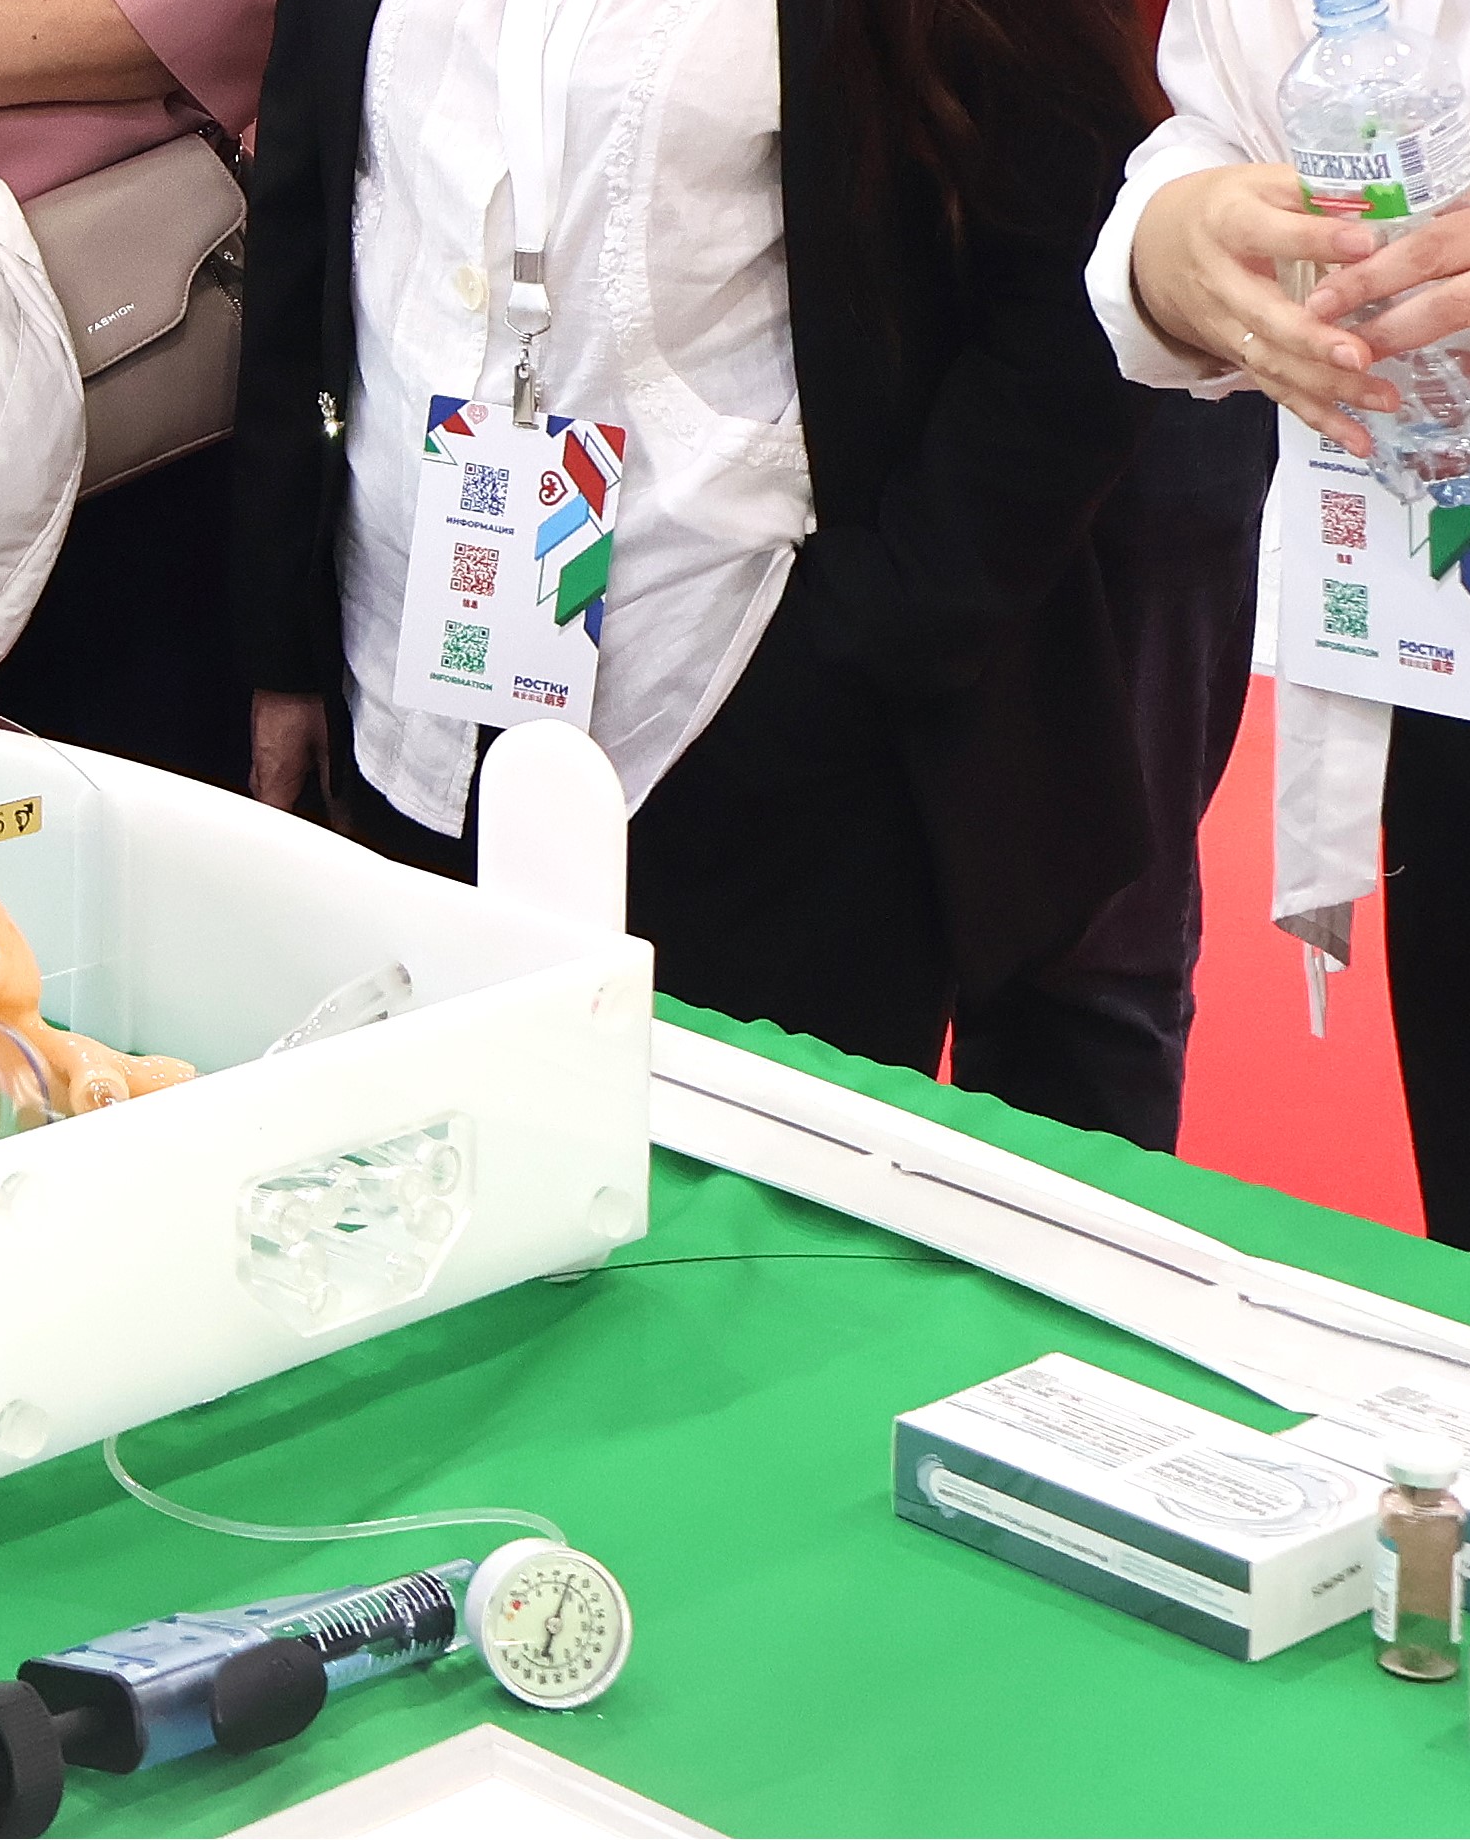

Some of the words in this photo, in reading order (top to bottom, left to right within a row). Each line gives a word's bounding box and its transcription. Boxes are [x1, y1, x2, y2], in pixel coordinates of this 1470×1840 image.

[445, 515, 515, 536] ИНФОРМАЦИЯ
[429, 672, 493, 691] INFORMATION
[513, 675, 569, 696] РОСТКИ
